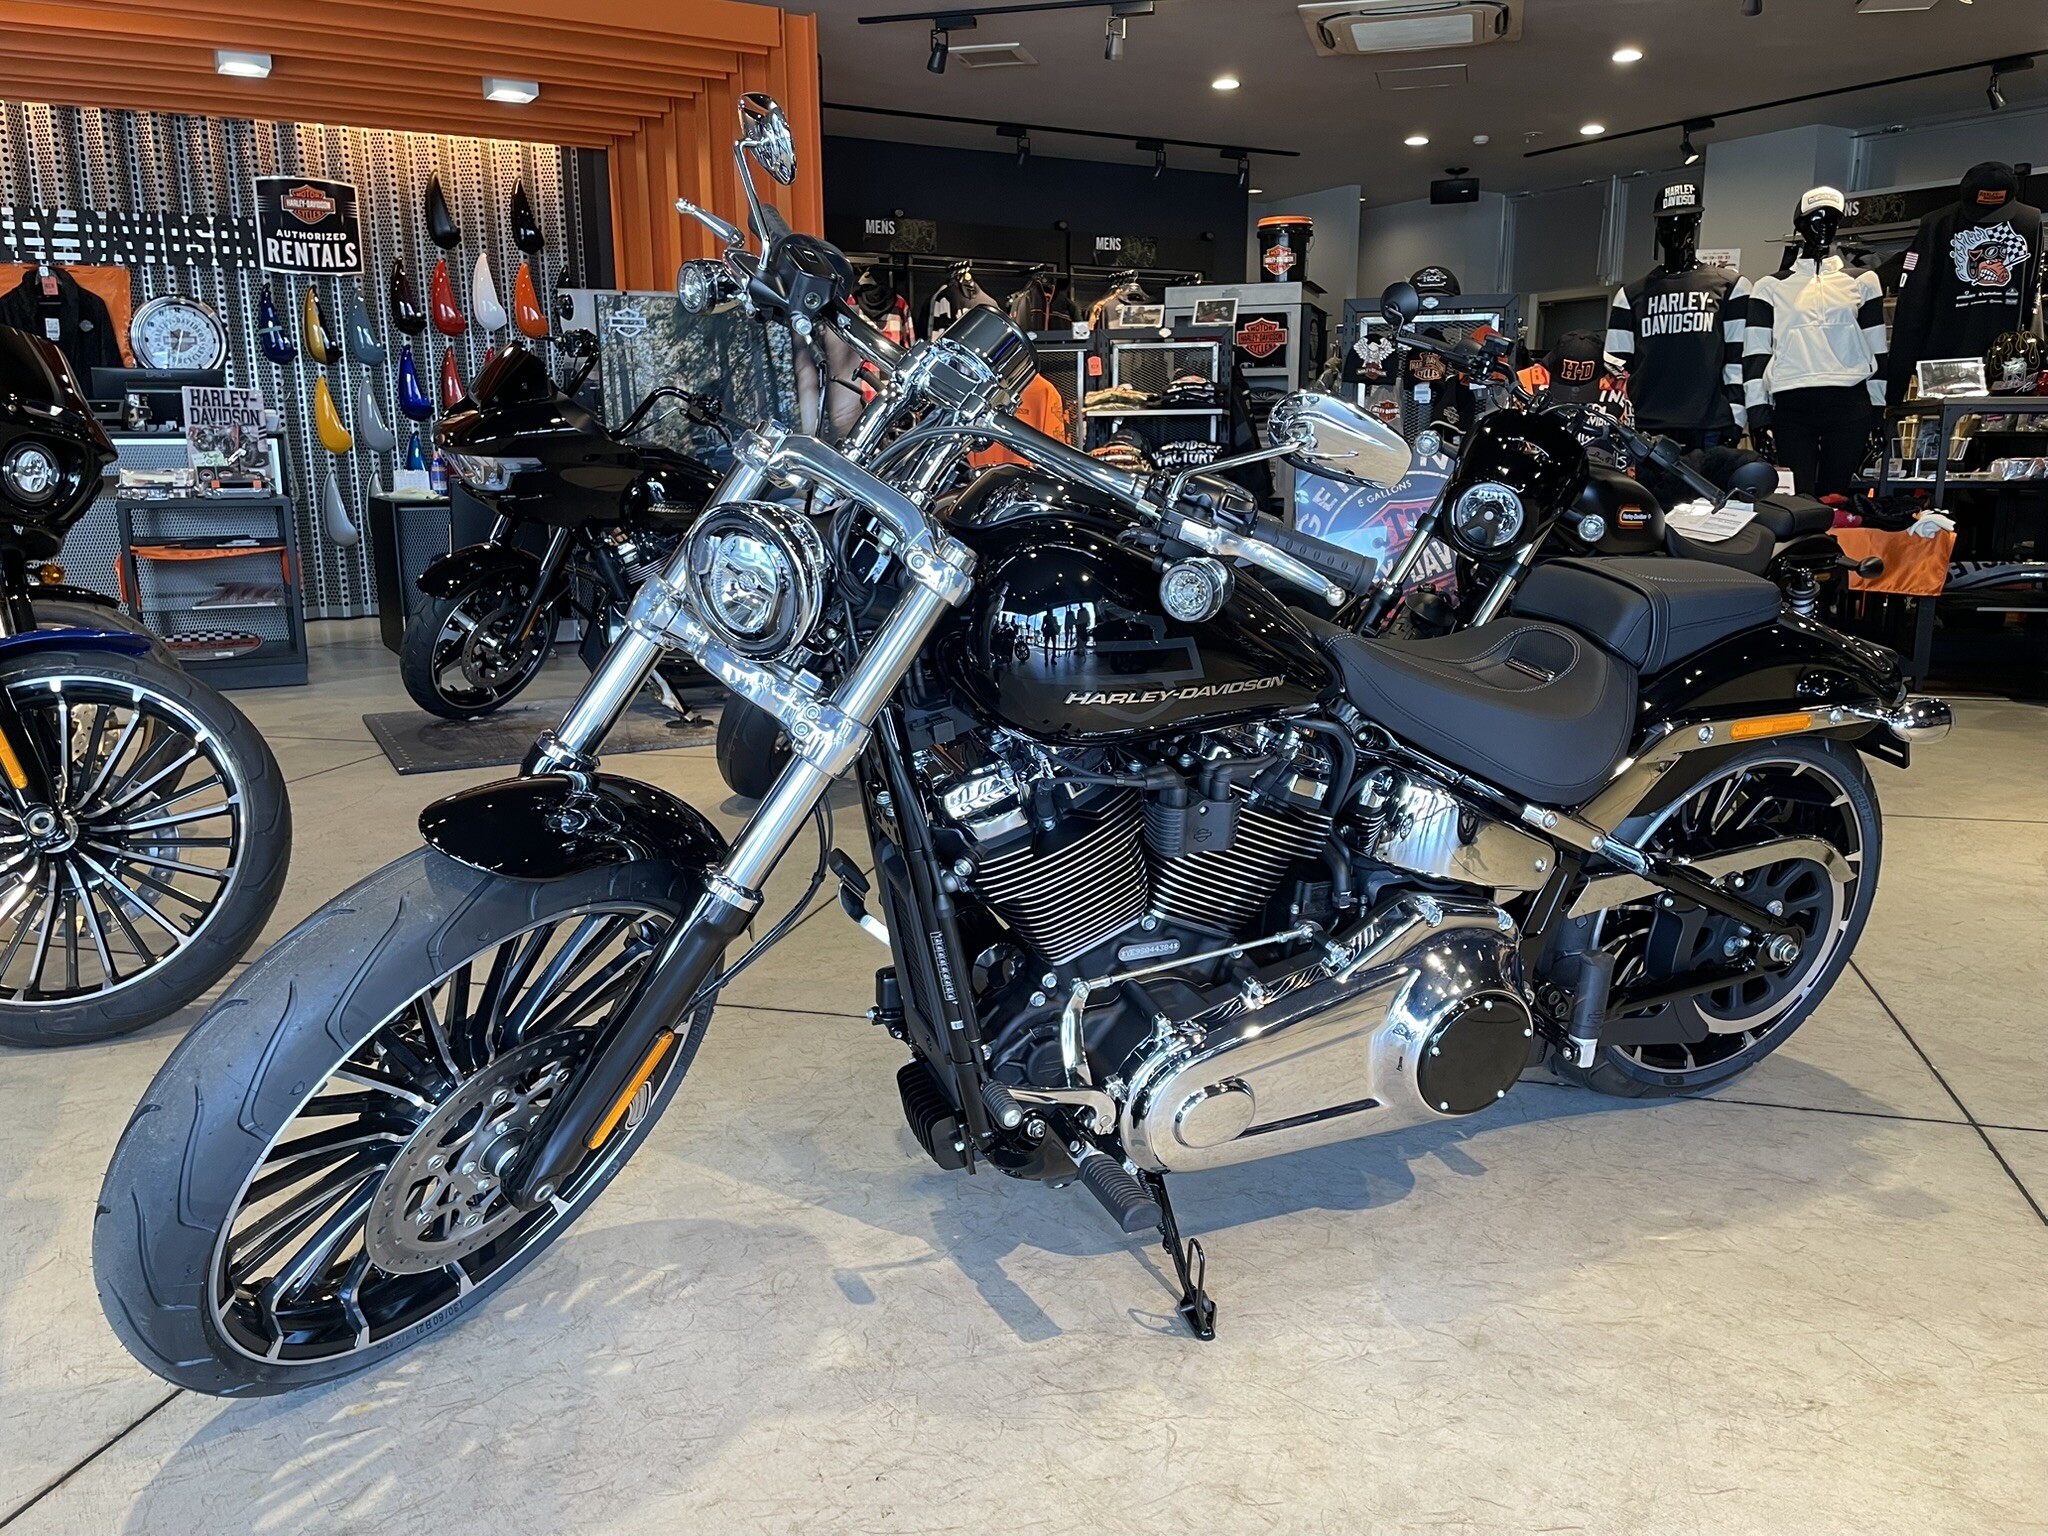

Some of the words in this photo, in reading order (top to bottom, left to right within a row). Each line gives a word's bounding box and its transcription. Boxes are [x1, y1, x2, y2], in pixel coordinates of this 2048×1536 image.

[1664, 184, 1695, 197] HARLEY-
[276, 229, 347, 241] AUTHORIZED
[866, 219, 896, 235] MENS
[266, 237, 358, 268] RENTALS
[1096, 236, 1122, 251] MENS
[1647, 291, 1714, 316] HARLEY-
[1641, 311, 1715, 338] DAVIDSON
[1561, 359, 1595, 380] H-D
[189, 388, 257, 408] HARLEY-
[189, 407, 260, 427] DAVIDSON
[1366, 479, 1412, 504] GALLONS
[1064, 673, 1286, 706] HARLEY-DAVIDSON
